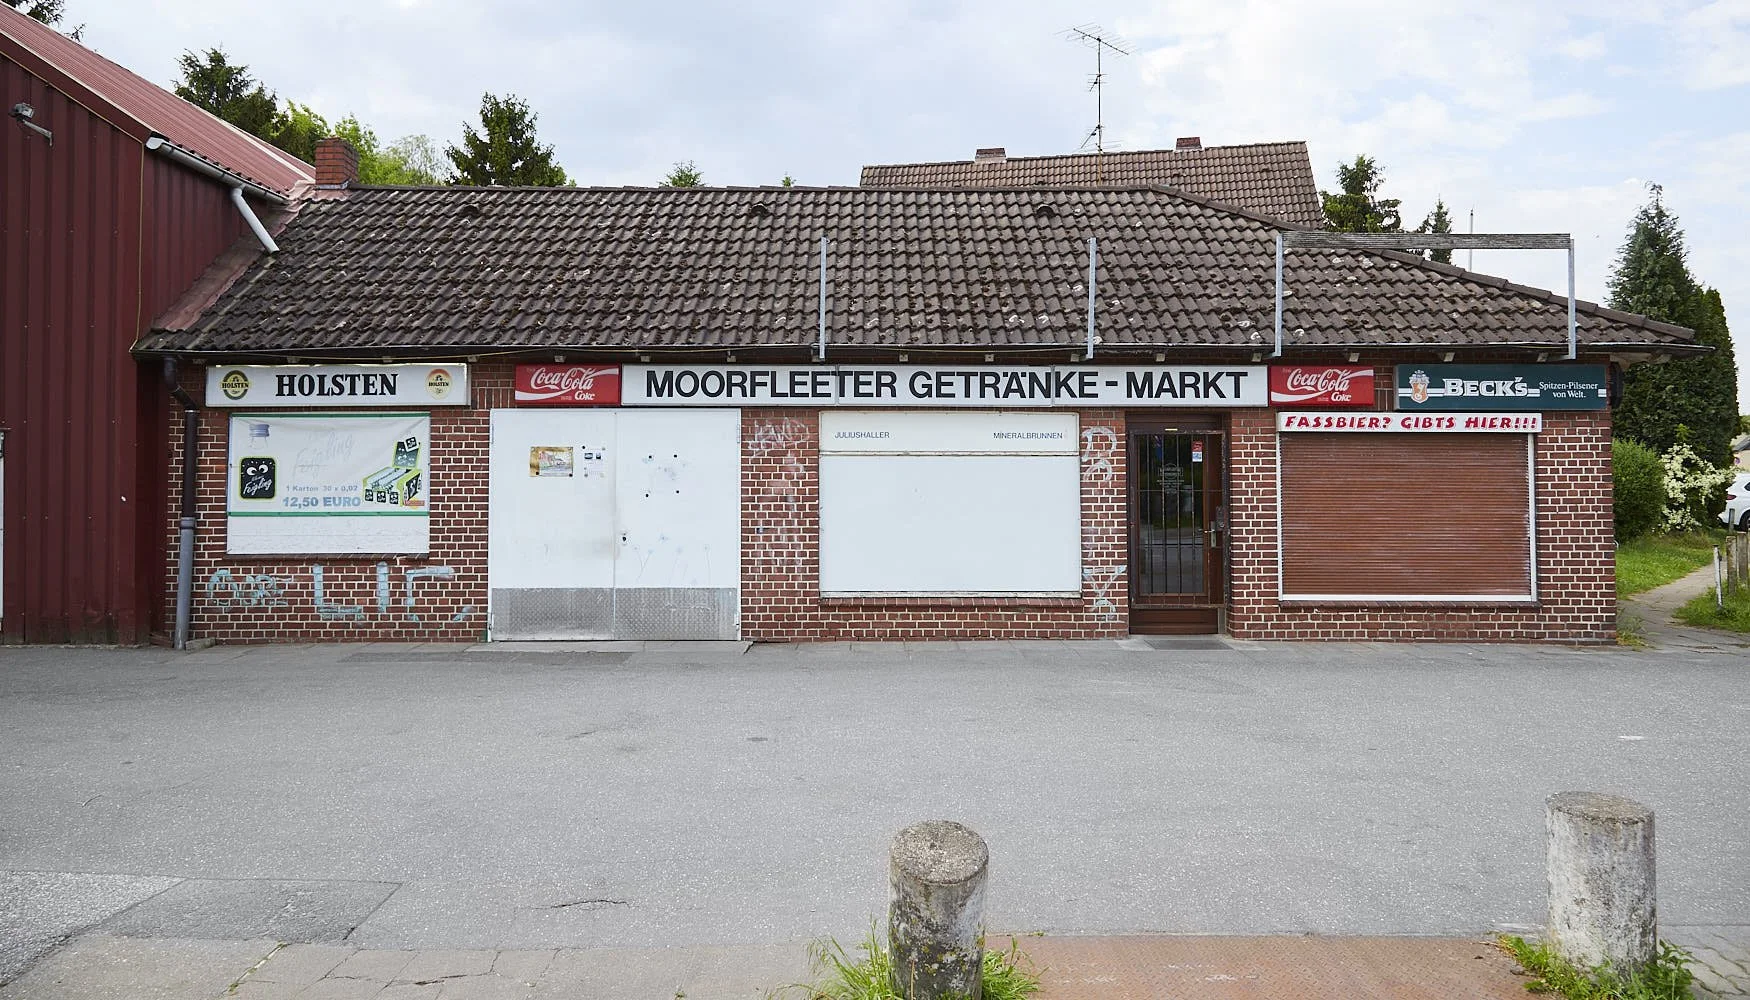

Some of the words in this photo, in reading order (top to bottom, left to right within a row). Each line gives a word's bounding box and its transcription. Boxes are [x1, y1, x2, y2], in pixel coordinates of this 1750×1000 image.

[275, 373, 398, 397] HOLSTEN
[530, 368, 595, 390] Coca-Cola
[646, 370, 897, 398] MOORFLEETER
[1287, 369, 1350, 391] Coca-Cola
[1539, 381, 1599, 392] Spitzen-Pilsener
[574, 391, 595, 400] Coke
[1330, 392, 1352, 402] Coke
[1567, 390, 1587, 398] Welt.
[1285, 416, 1391, 428] FASSBIER?
[1400, 416, 1456, 429] GIBTS
[1465, 417, 1537, 429] HIER!!!
[835, 431, 890, 439] JULIUSHALLER
[993, 432, 1063, 440] MINERALBRUNNEN
[283, 496, 319, 509] 12,50
[323, 496, 361, 507] EURO
